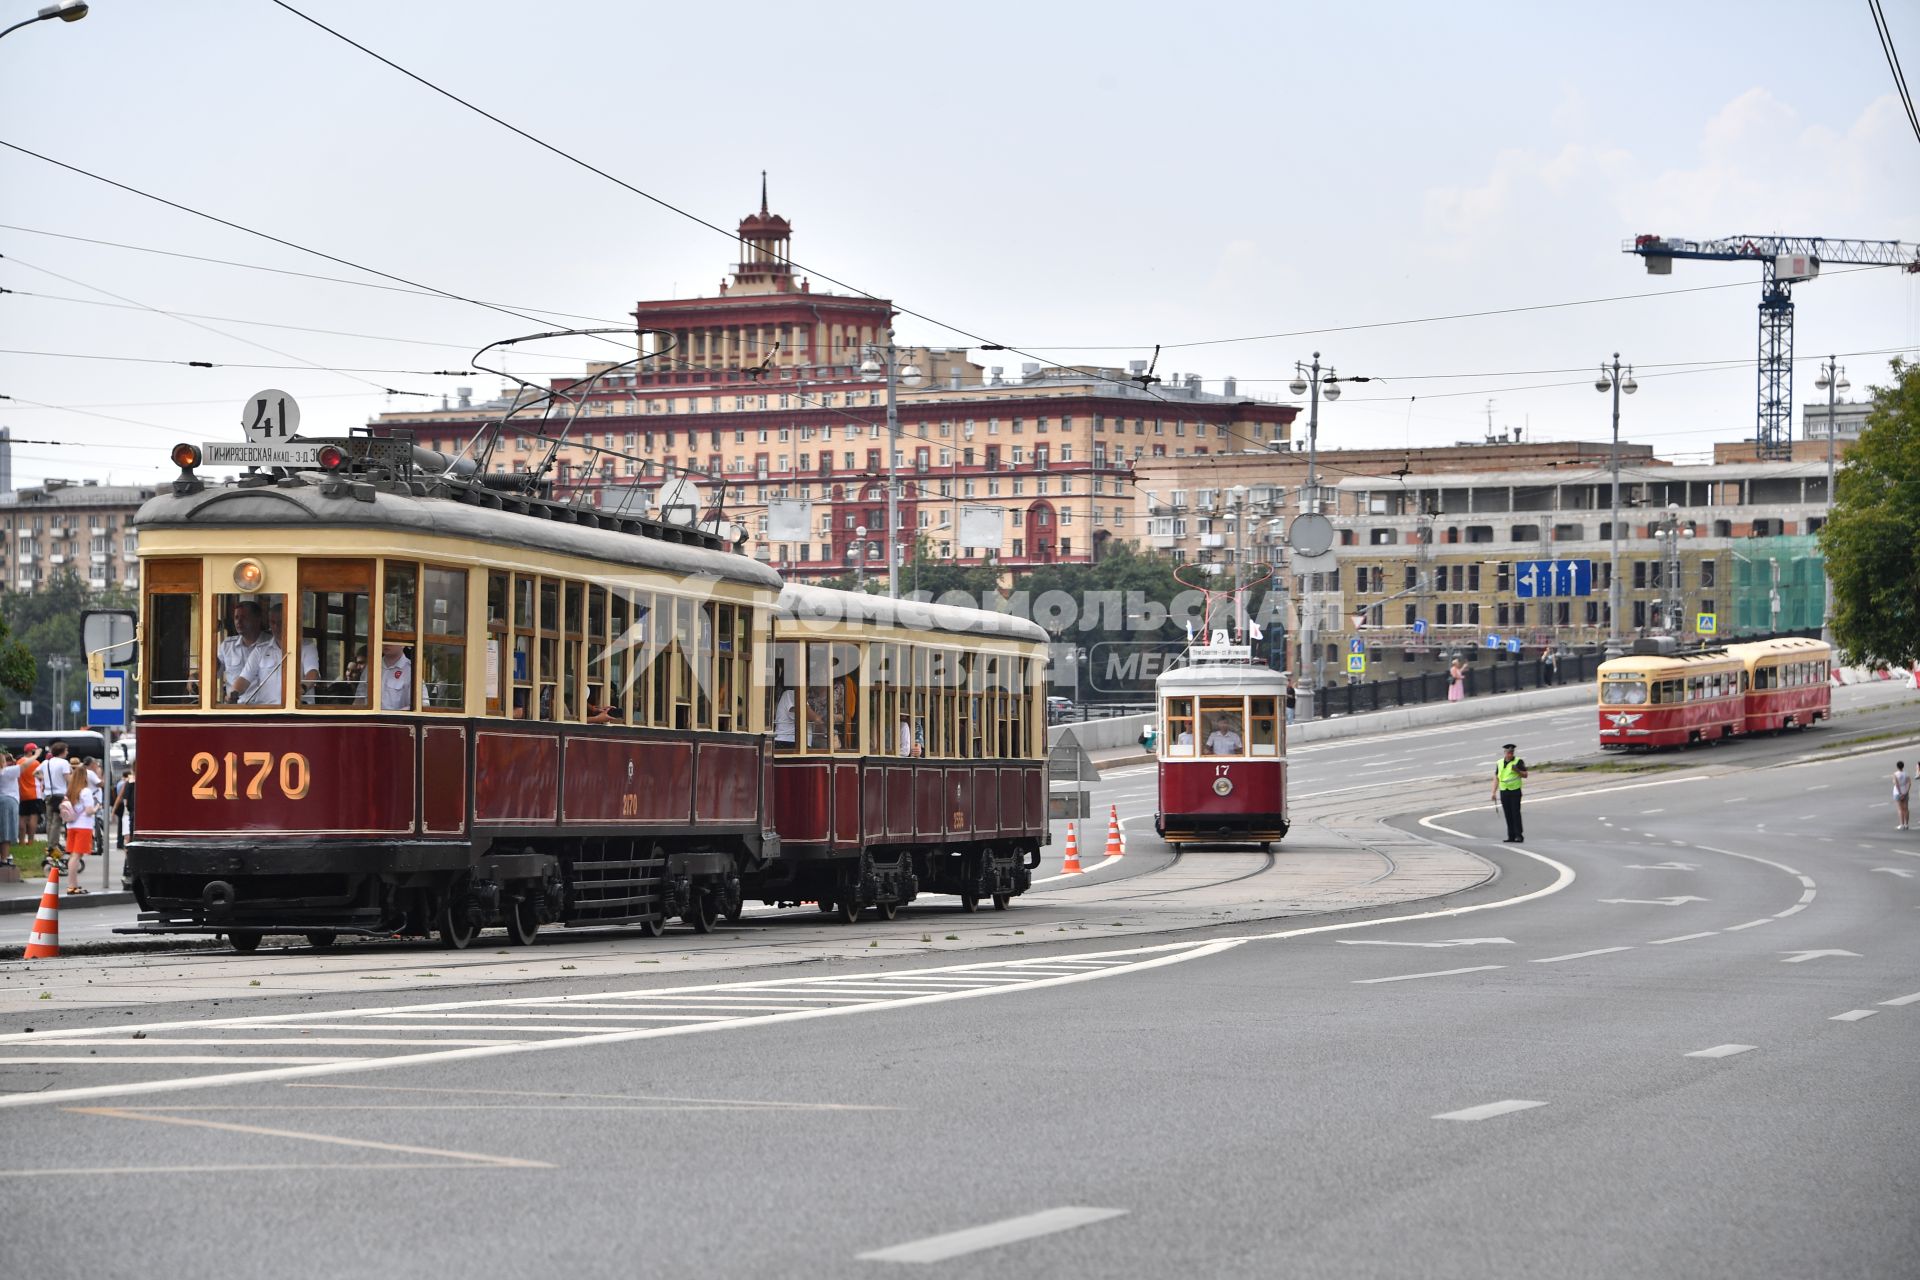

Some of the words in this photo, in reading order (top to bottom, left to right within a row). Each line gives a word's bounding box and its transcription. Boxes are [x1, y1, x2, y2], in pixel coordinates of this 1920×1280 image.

[251, 397, 287, 438] 41
[1216, 632, 1225, 645] 2
[191, 751, 311, 800] 2170
[1215, 764, 1230, 776] 17
[623, 794, 638, 815] 2170
